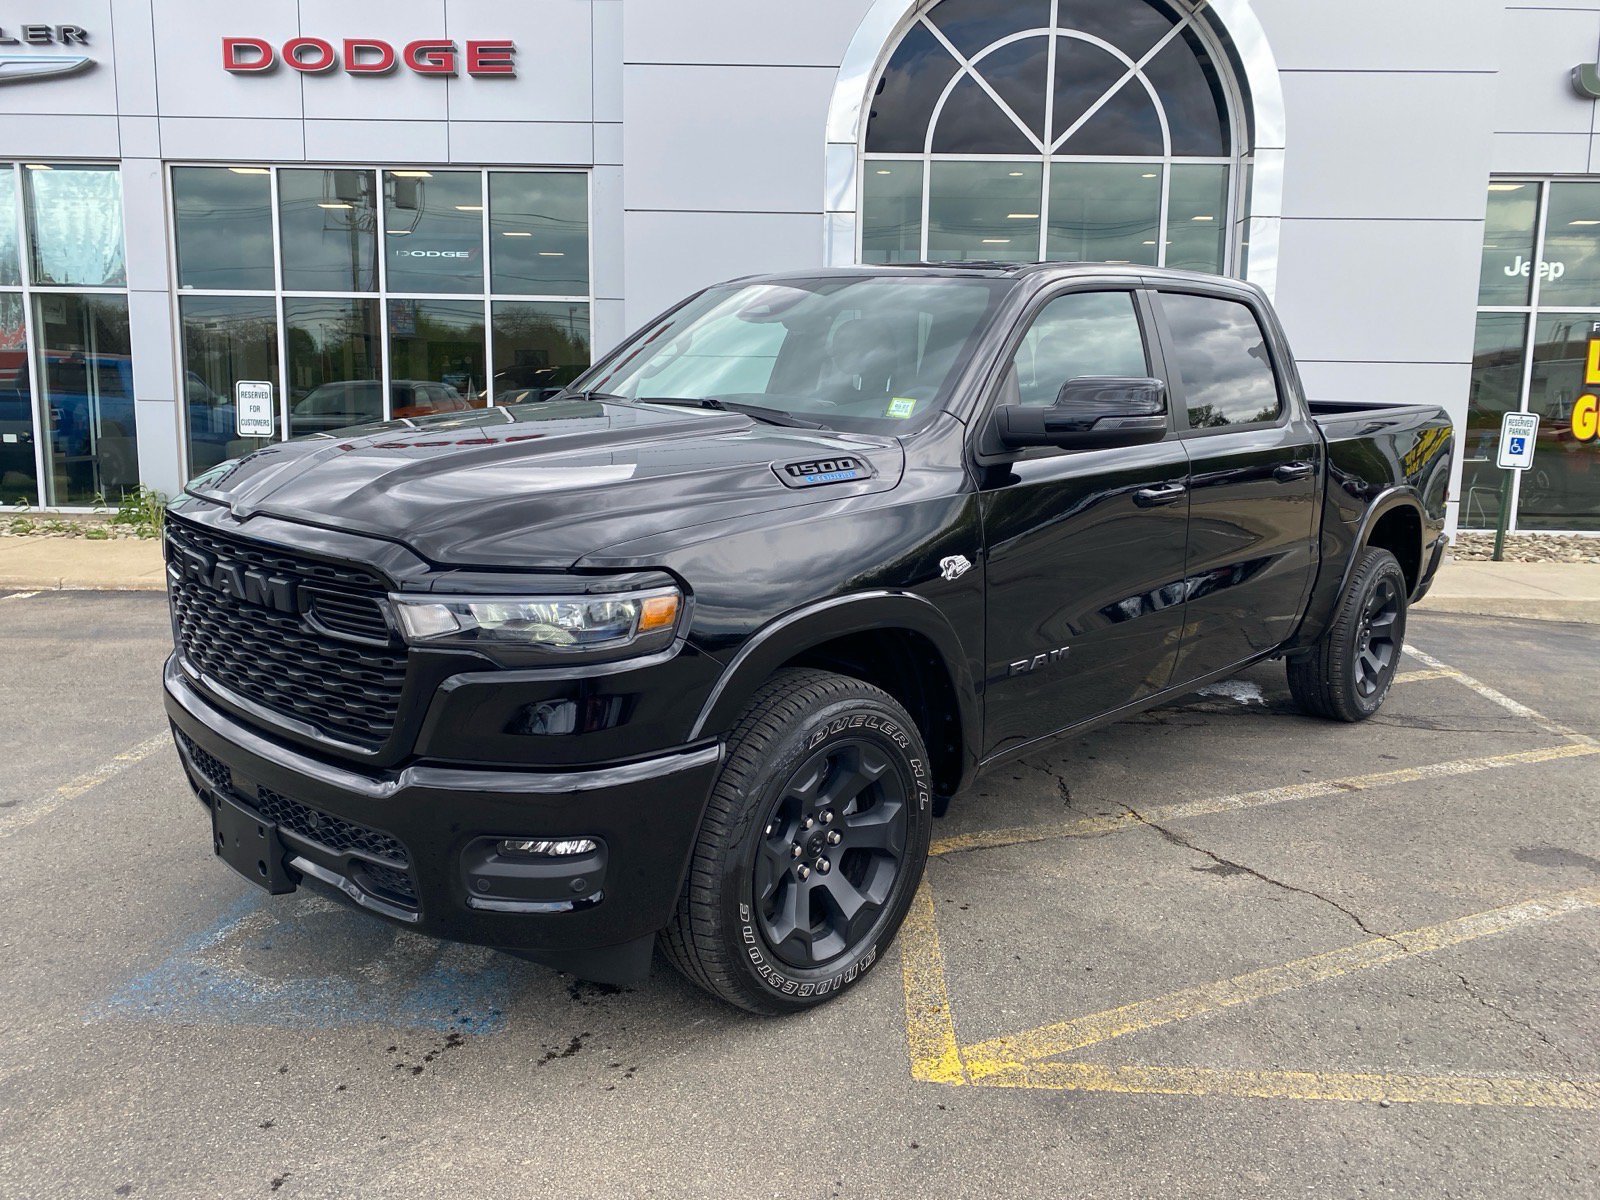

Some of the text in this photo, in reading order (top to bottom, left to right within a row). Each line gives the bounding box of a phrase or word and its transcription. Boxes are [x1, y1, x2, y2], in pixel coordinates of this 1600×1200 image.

[222, 37, 516, 77] DODGE
[396, 249, 470, 259] DODGE
[1504, 255, 1565, 282] Jeep
[240, 391, 268, 399] RESERVED
[240, 418, 270, 426] CUSTOMERS
[1508, 418, 1534, 427] RESERVED
[1508, 428, 1531, 436] PARKING
[790, 459, 855, 476] 1500
[182, 545, 299, 614] RAM
[1008, 646, 1070, 677] RAM
[808, 713, 930, 812] DUELER H/L
[739, 902, 877, 998] BRIDGESTONE
